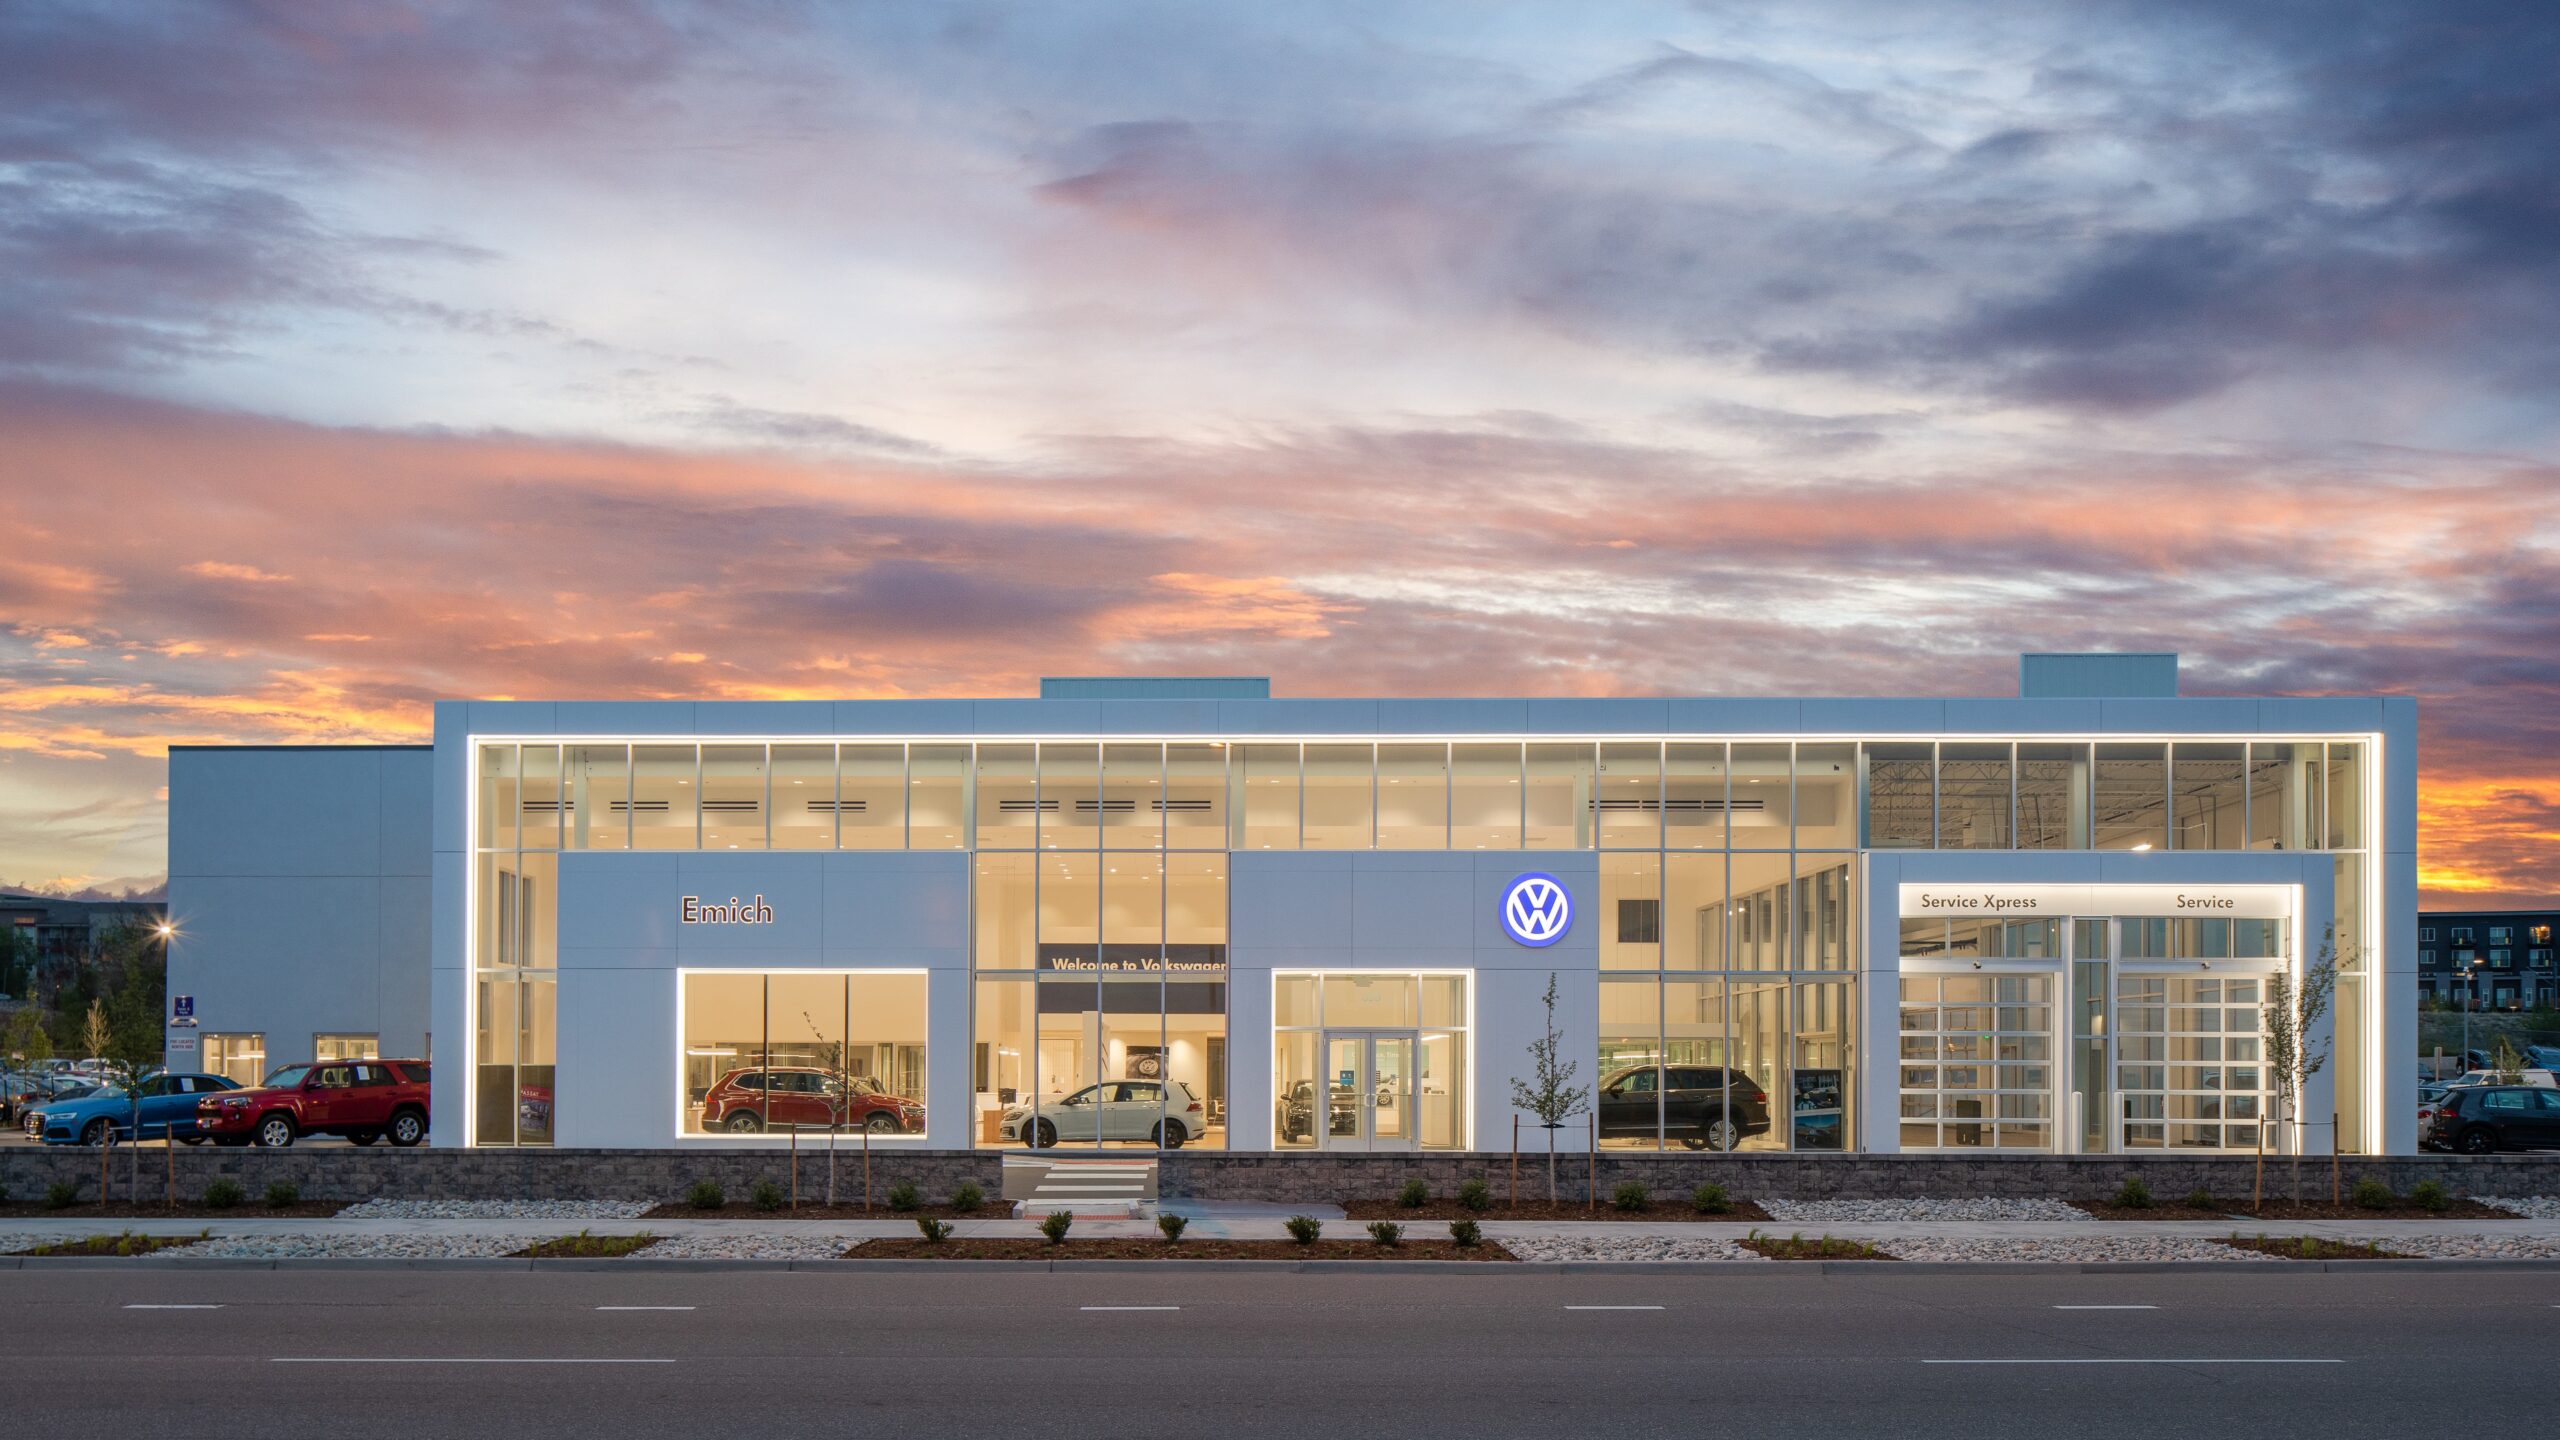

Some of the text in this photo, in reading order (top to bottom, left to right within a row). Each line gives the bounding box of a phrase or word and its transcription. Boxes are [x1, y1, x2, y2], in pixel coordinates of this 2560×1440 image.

[682, 895, 773, 923] Emich
[1507, 879, 1568, 940] VW
[1921, 894, 2037, 911] Service Xpress
[2177, 894, 2234, 908] Service
[1052, 958, 1226, 970] Welcome to Vokswagen
